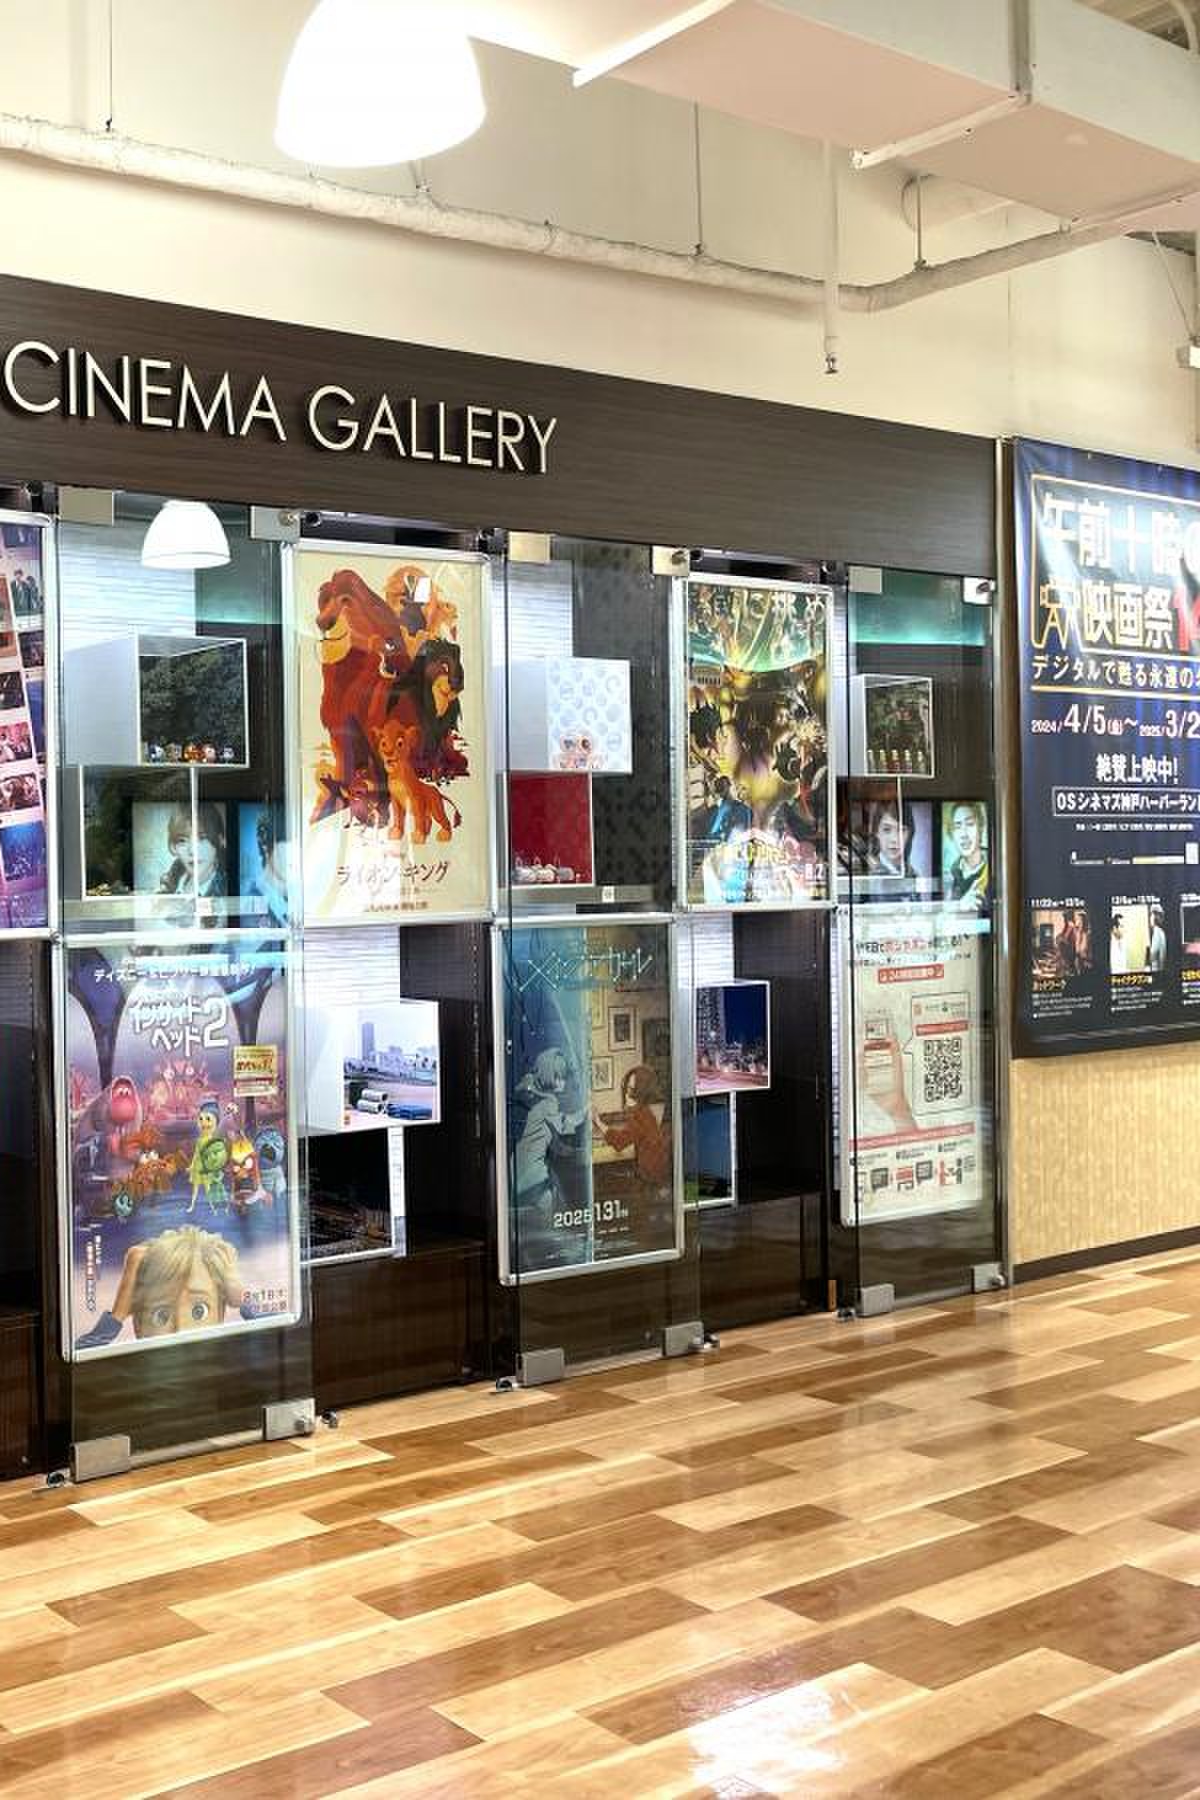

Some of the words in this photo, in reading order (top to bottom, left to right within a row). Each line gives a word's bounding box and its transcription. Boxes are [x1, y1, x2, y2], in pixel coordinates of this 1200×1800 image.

[2, 340, 287, 442] CINEMA
[308, 384, 557, 474] GALLERY
[1081, 578, 1173, 650] 映画祭
